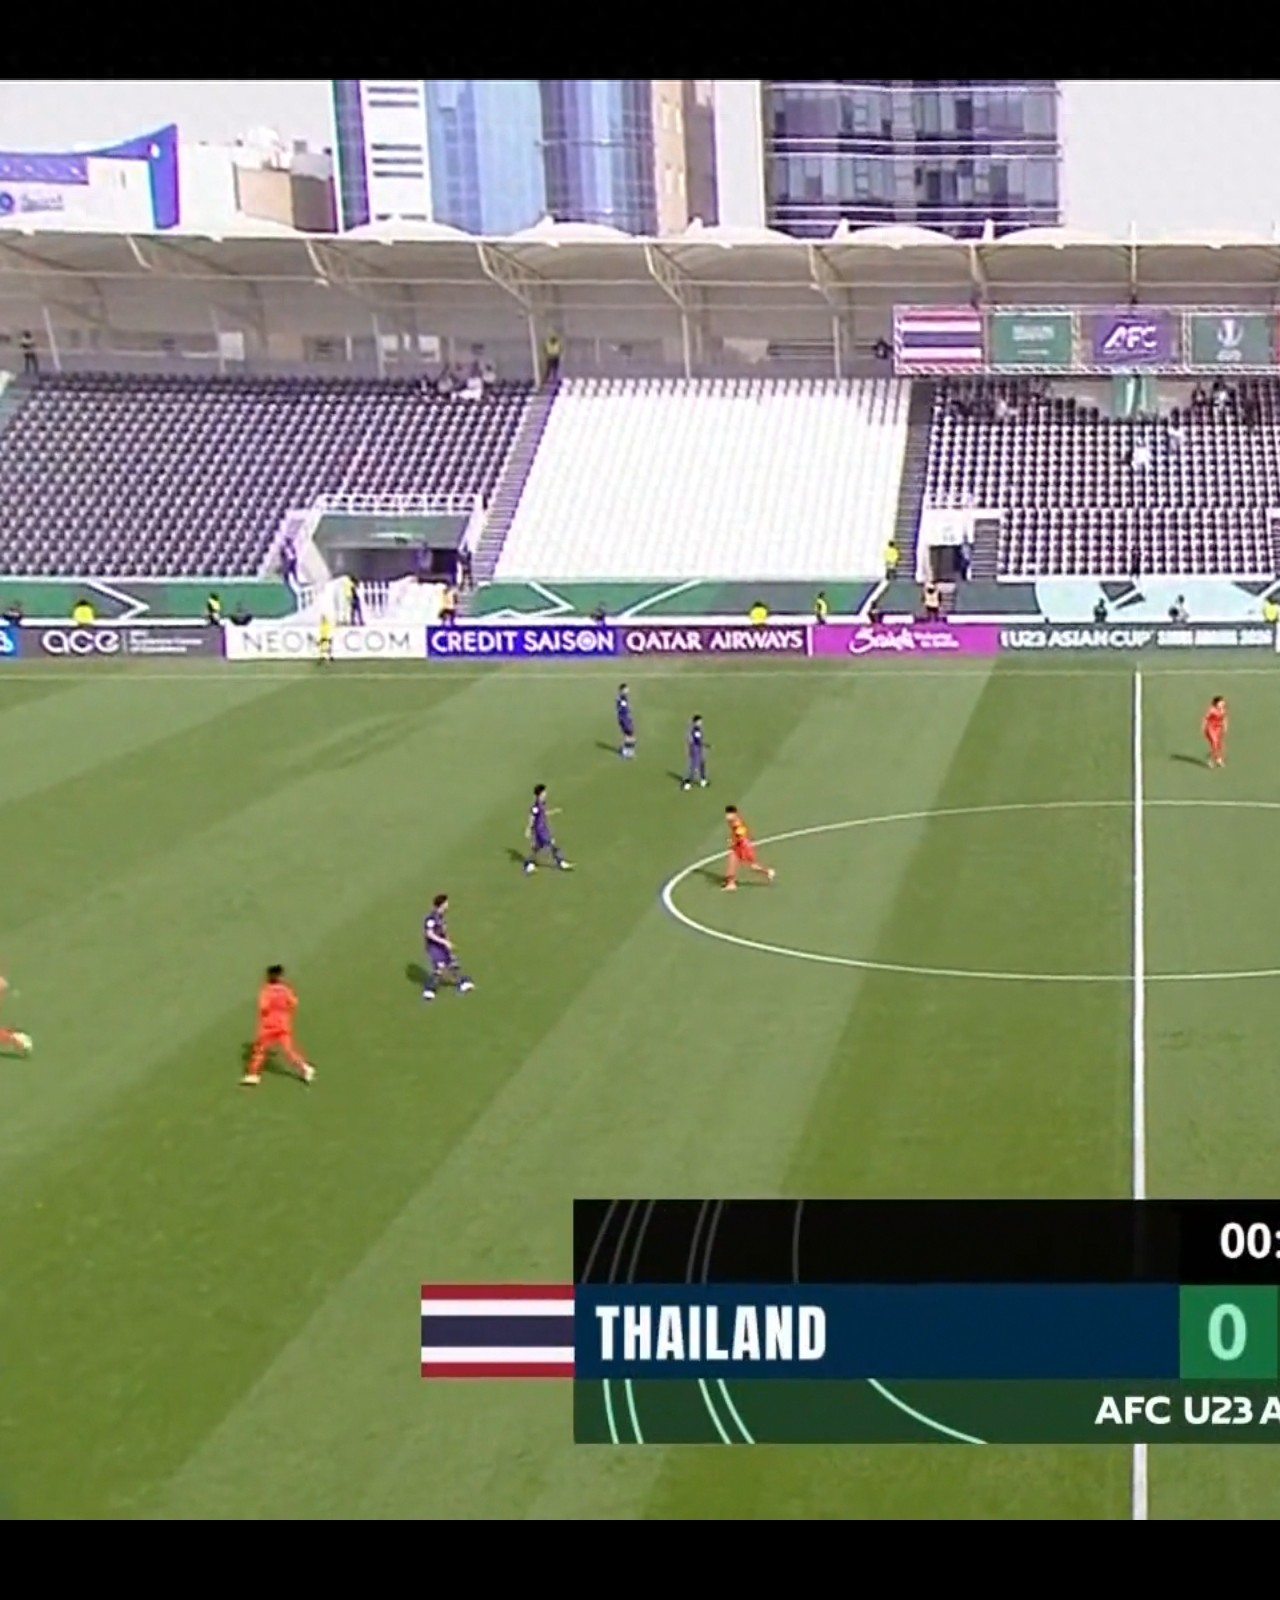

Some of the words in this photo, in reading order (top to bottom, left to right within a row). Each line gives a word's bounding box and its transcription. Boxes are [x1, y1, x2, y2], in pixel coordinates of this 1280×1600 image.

[1103, 325, 1158, 349] AFC
[42, 630, 120, 654] ace
[431, 630, 518, 653] CREDIT
[523, 629, 615, 652] SAISON
[626, 630, 702, 652] QATAR
[710, 629, 802, 651] AIRWAYS
[1009, 630, 1047, 647] U23
[1048, 630, 1108, 647] ASIAN
[1109, 630, 1152, 647] CUP
